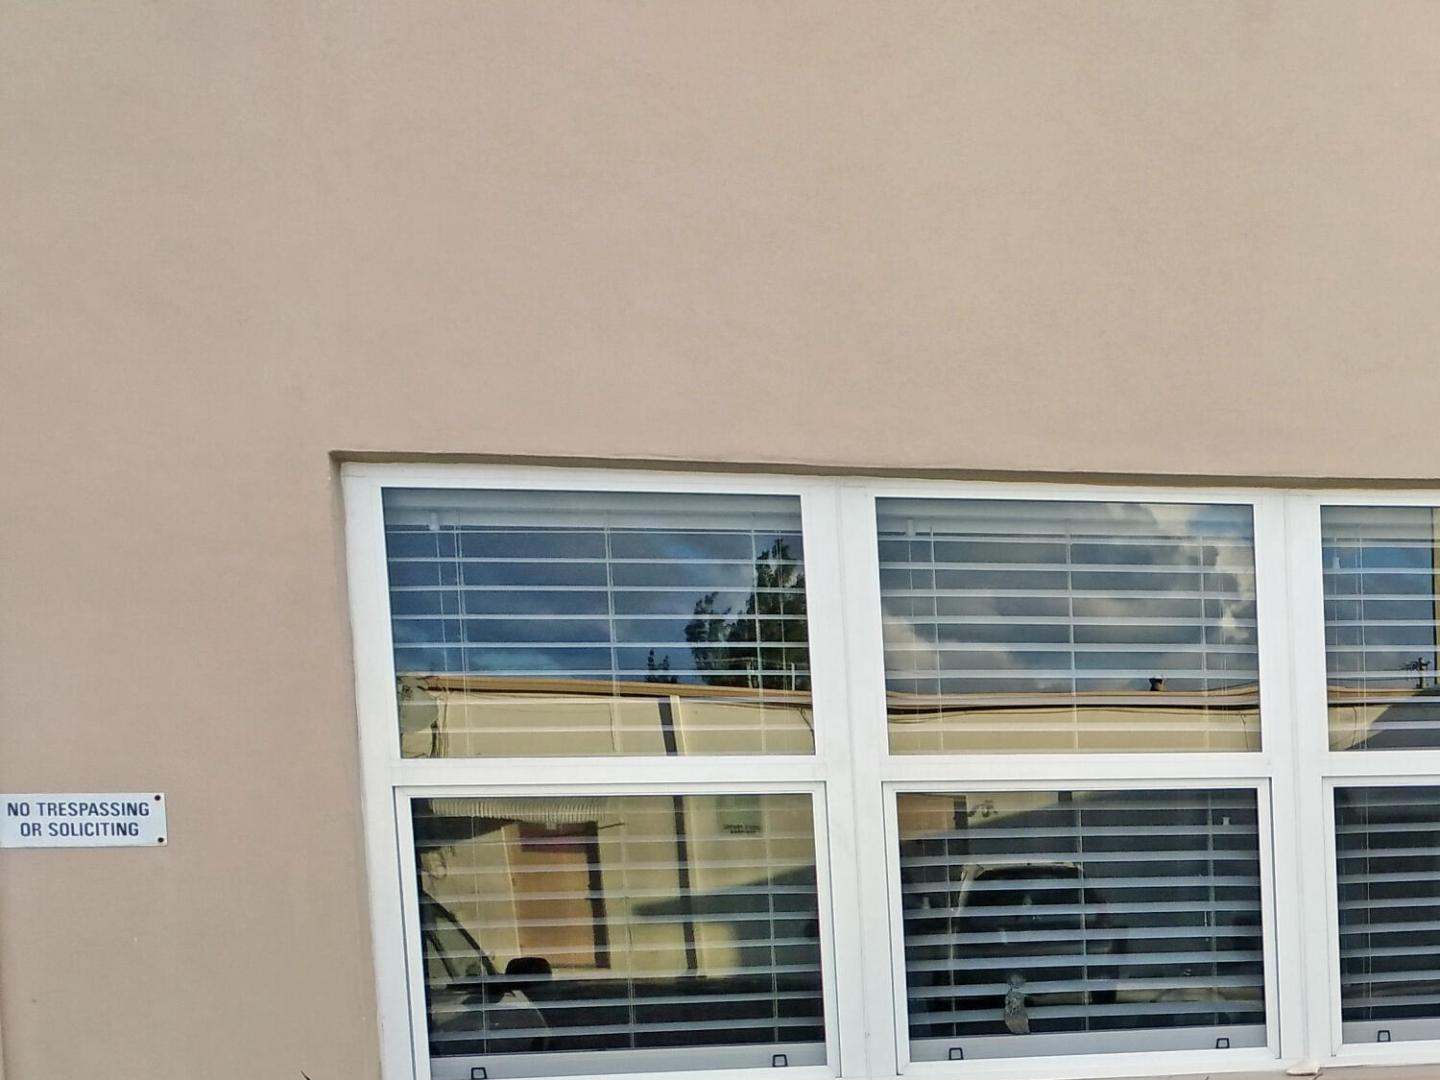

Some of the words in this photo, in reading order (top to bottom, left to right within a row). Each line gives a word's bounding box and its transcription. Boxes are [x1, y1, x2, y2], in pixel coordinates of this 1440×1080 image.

[7, 802, 30, 817] NO
[36, 802, 150, 817] TRESPASSING
[20, 822, 42, 837] OR
[48, 822, 139, 837] SOLICITING
